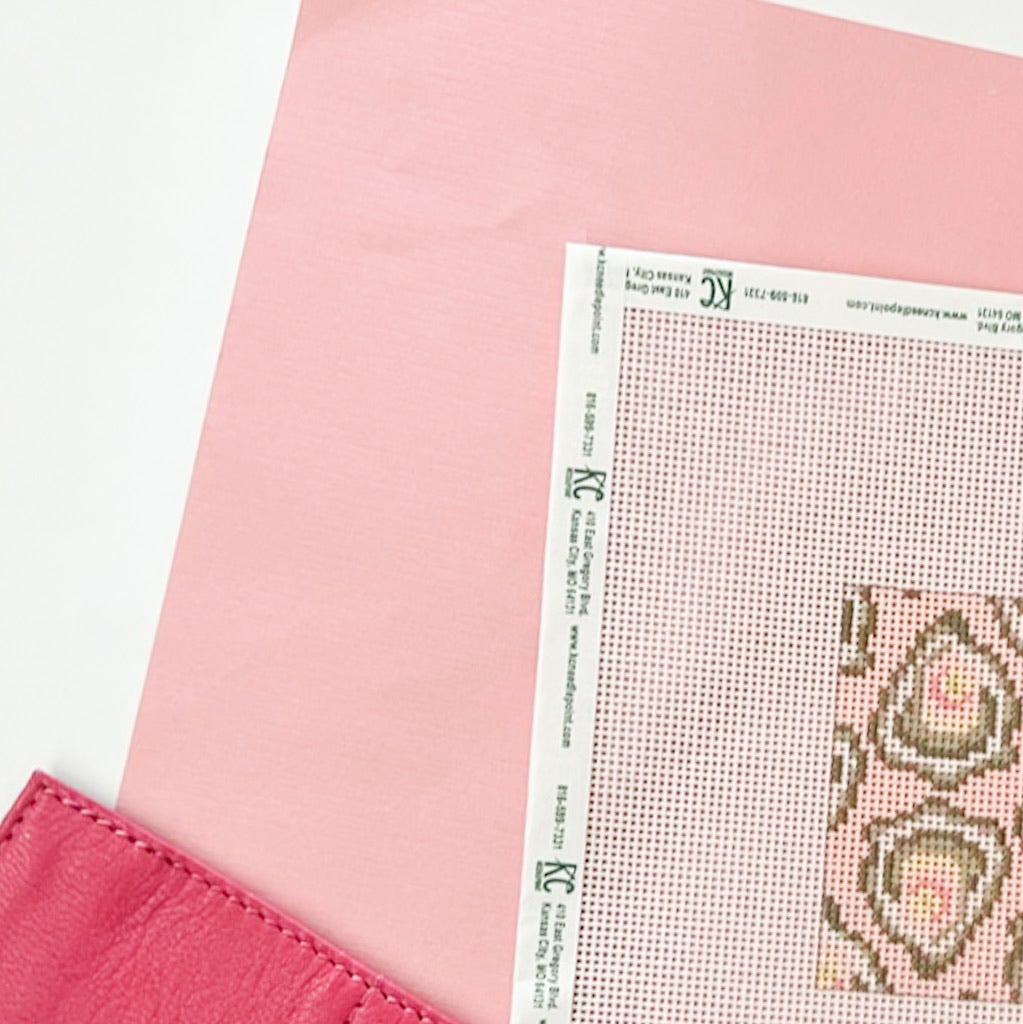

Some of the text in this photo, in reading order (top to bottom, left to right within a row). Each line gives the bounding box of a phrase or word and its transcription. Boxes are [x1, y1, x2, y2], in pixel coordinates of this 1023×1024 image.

[657, 271, 692, 285] Kansas
[651, 285, 672, 297] East
[699, 276, 733, 311] KC
[846, 300, 968, 320] www.kcneedlepoint.com
[1005, 310, 1021, 322] MO
[977, 321, 999, 334] Blvd.
[572, 467, 607, 502] KC
[569, 509, 582, 544] Kansas
[584, 528, 595, 550] East
[565, 547, 579, 567] City,
[567, 570, 577, 586] MO
[579, 551, 593, 591] Gregory
[578, 593, 591, 616] Blvd.
[542, 860, 577, 895] KC
[539, 902, 552, 937] Kansas
[553, 921, 565, 942] East
[535, 964, 547, 980] MO
[547, 944, 563, 984] Gregory
[547, 986, 560, 1010] Blvd.
